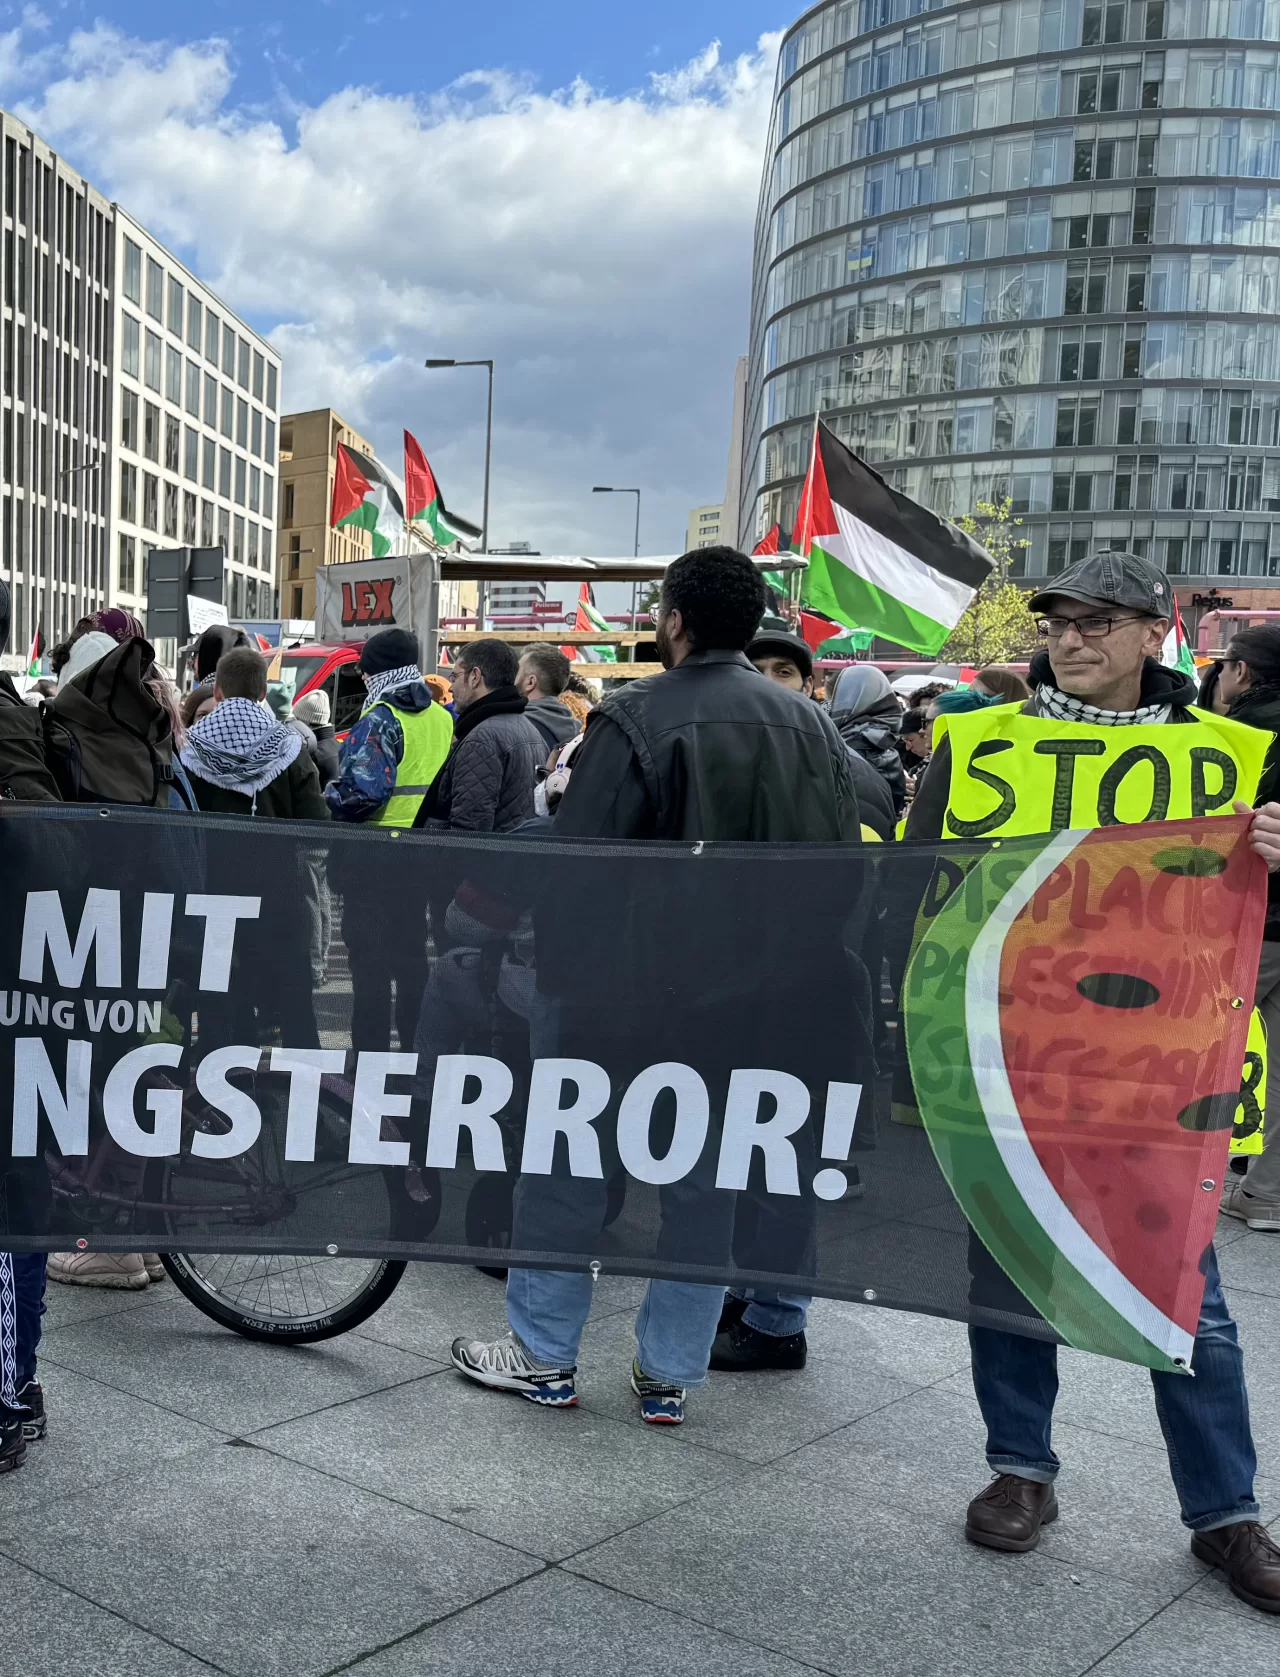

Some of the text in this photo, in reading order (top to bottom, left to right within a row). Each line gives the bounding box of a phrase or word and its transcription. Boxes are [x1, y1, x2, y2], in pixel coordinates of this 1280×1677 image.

[341, 578, 397, 627] LEX
[1192, 593, 1234, 612] Regus
[946, 739, 1238, 838] STOP
[19, 888, 262, 993] MIT
[83, 999, 162, 1034] VON
[241, 1316, 277, 1332] STERN
[531, 1374, 560, 1383] SALOMON
